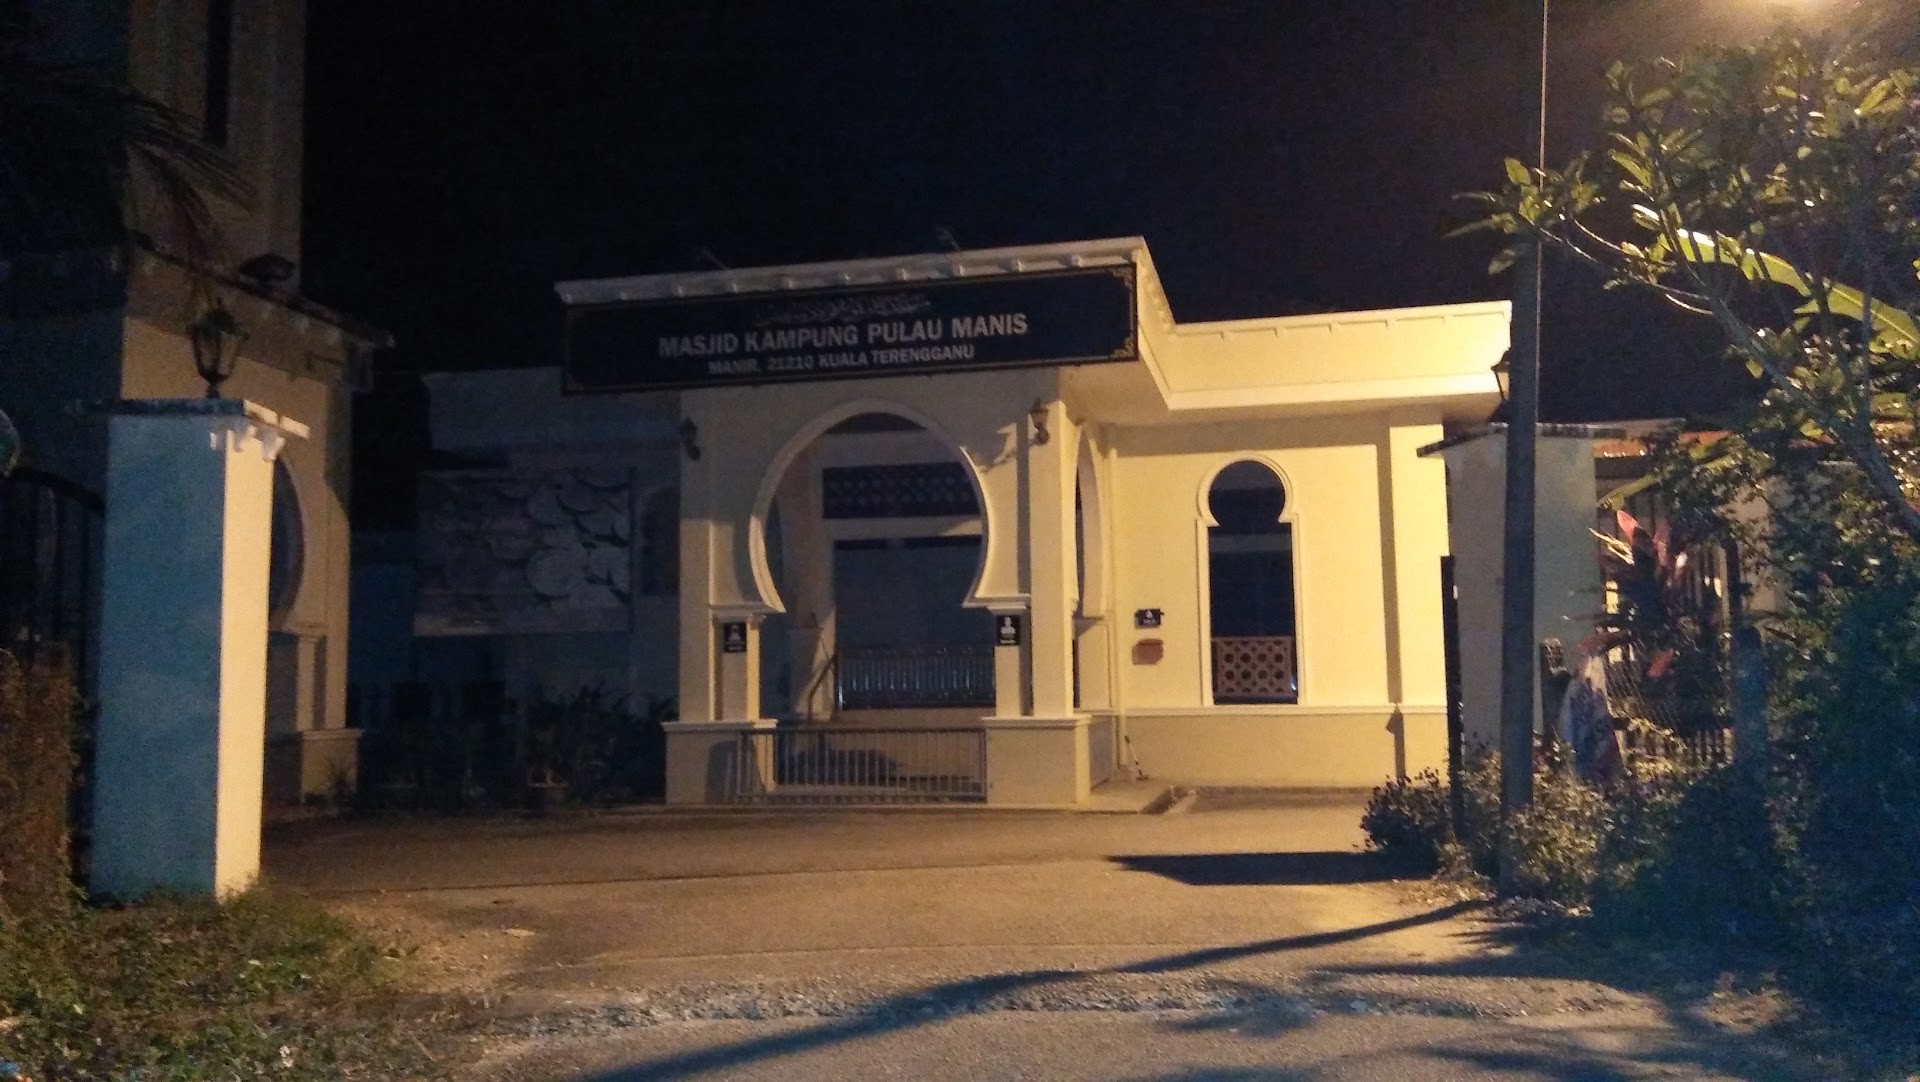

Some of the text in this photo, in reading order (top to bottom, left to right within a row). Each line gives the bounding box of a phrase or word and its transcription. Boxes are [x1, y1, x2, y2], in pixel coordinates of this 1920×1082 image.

[658, 333, 740, 358] MASJID
[744, 324, 859, 353] KAMPUNG
[867, 319, 944, 344] PULAU
[951, 312, 1030, 338] MANIS
[818, 350, 869, 368] KUALA
[870, 343, 976, 366] TERENGGANU
